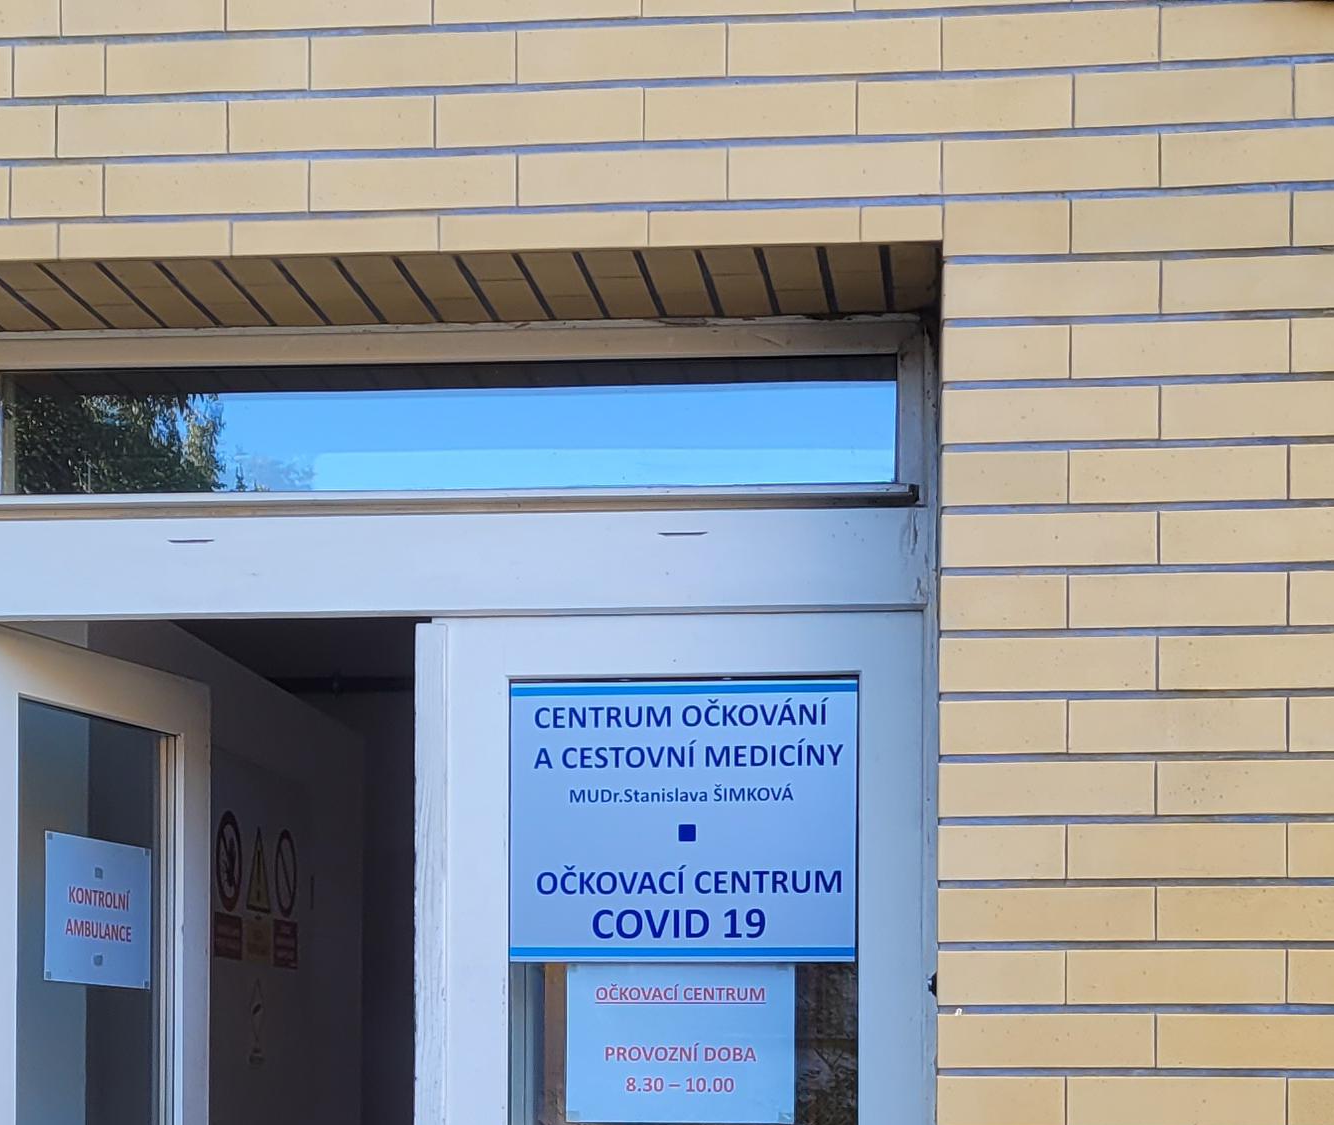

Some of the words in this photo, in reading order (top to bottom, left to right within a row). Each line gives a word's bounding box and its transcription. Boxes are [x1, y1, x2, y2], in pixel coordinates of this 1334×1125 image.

[534, 705, 671, 729] CENTRUM
[681, 697, 829, 727] OČKOVÁNÍ
[533, 747, 553, 769] A
[562, 740, 697, 769] CESTOVNÍ
[704, 738, 843, 768] MEDICÍNY
[569, 787, 708, 804] MUDr.Stanislava
[713, 783, 794, 802] ŠIMKOVÁ
[536, 865, 687, 895] OČKOVACÍ
[694, 870, 843, 894] CENTRUM
[68, 885, 131, 913] KONTROLNÍ
[65, 918, 132, 943] AMBULANCE
[592, 909, 710, 939] COVID
[723, 908, 766, 939] 19
[595, 983, 679, 1001] OČKOVACÍ
[683, 986, 765, 1001] CENTRUM
[604, 1043, 699, 1062] PROVOZNÍ
[704, 1047, 757, 1062] DOBA
[626, 1077, 664, 1093] 8.30
[685, 1077, 735, 1093] 10.00
